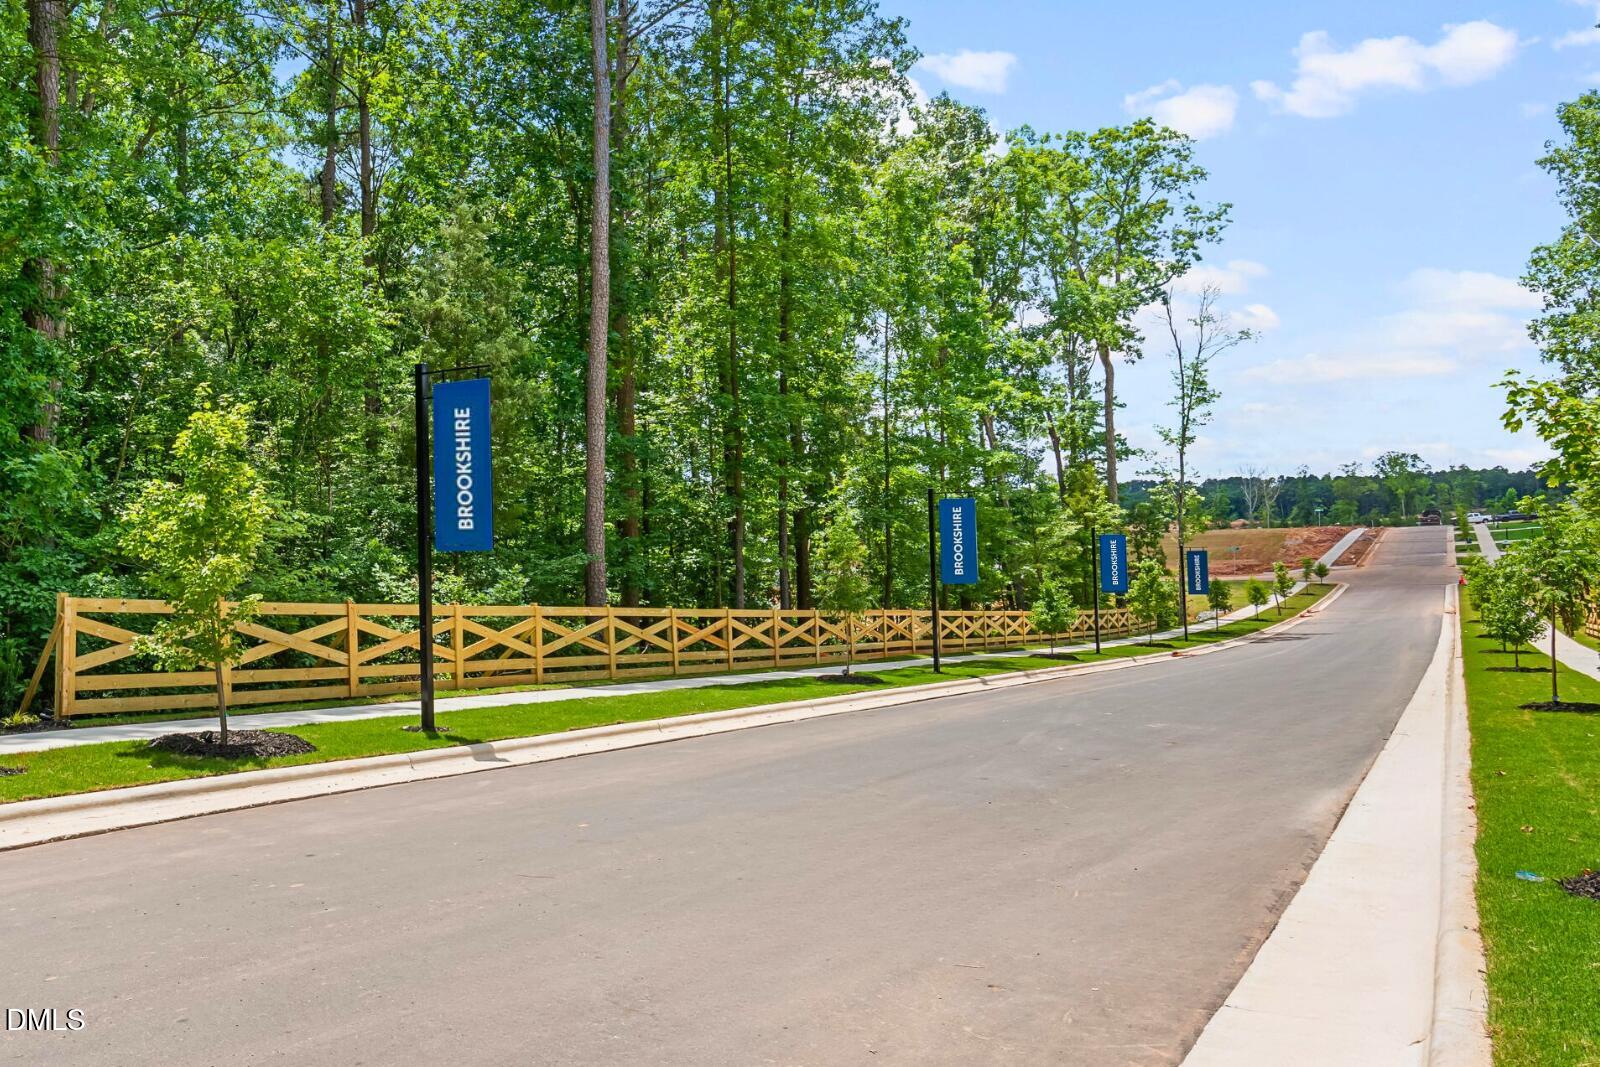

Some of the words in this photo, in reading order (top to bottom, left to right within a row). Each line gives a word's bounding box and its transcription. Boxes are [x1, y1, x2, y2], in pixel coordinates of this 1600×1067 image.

[454, 407, 474, 530] BROOKSHIRE
[952, 506, 964, 575] BROOKSHIRE
[1109, 539, 1119, 585] BROOKSHIRE
